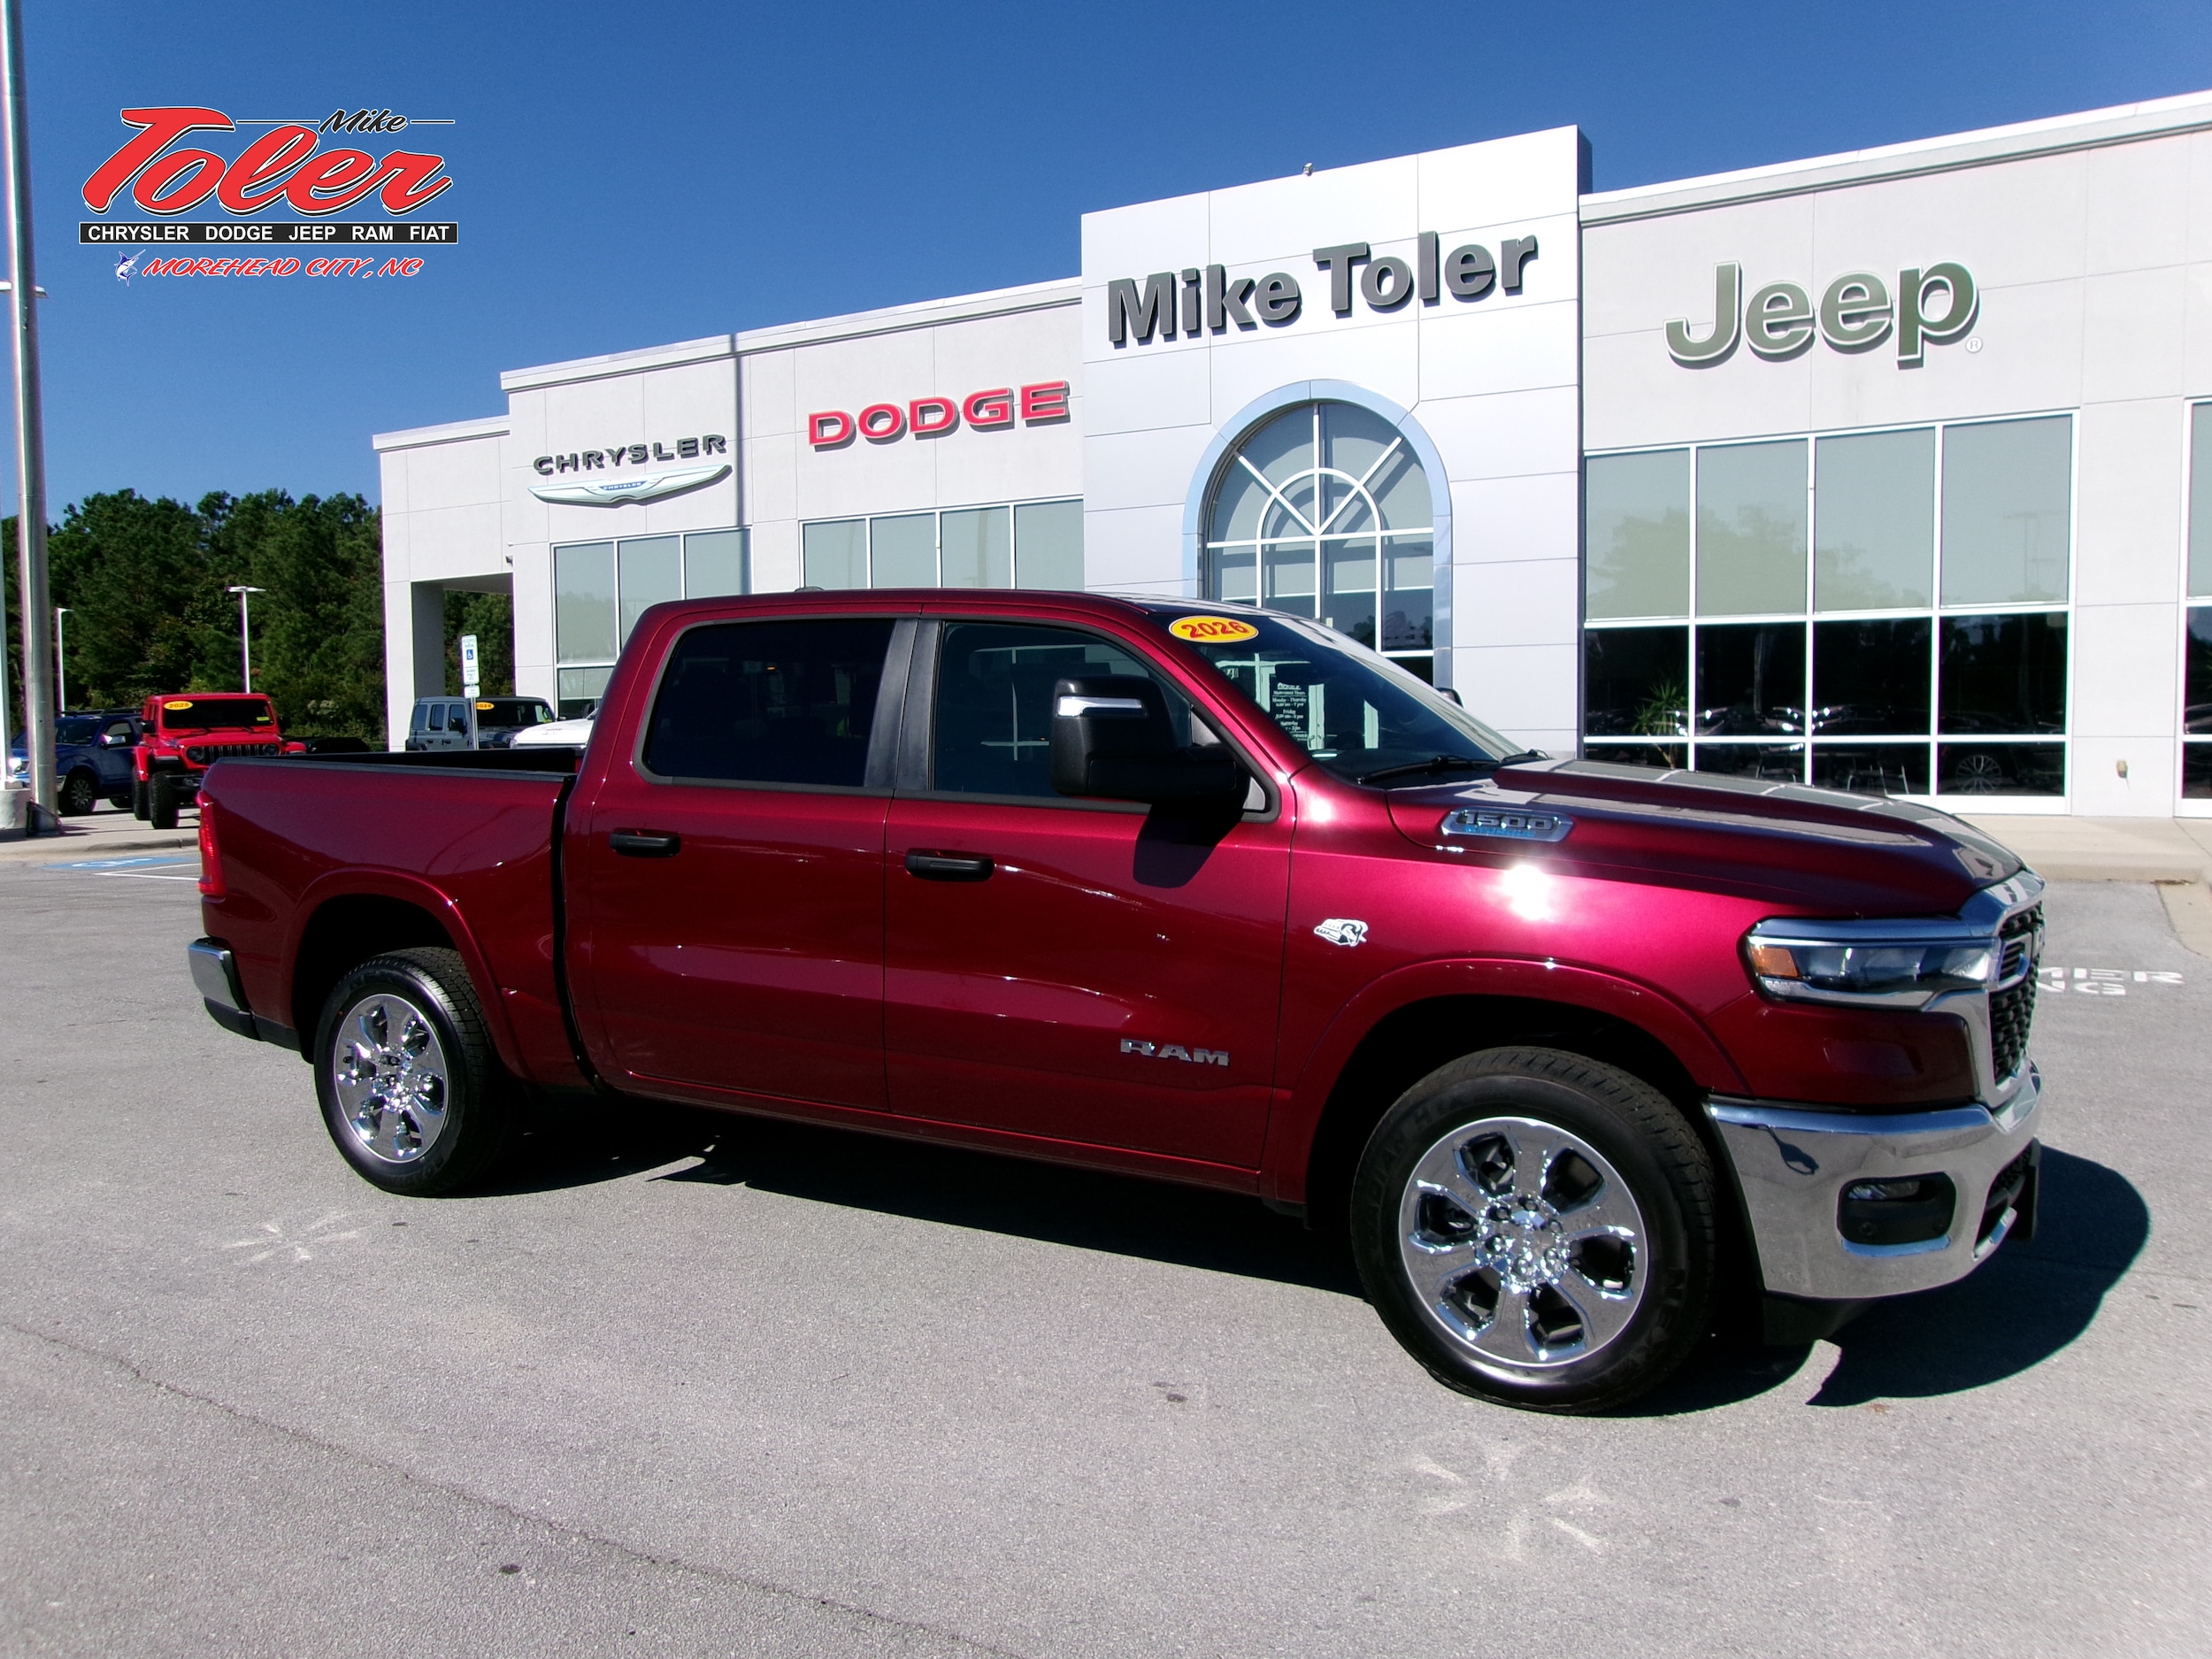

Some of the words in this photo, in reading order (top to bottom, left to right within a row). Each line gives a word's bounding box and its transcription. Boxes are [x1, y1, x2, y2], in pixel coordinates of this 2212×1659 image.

[1108, 264, 1301, 349] Mike
[1312, 231, 1540, 319] Toler
[1663, 260, 1980, 370] Jeep
[809, 380, 1070, 450] DODGE
[533, 434, 727, 474] CHRYSLER
[1181, 621, 1249, 639] 2026
[1464, 813, 1552, 829] 1500
[1120, 1038, 1230, 1067] RAM
